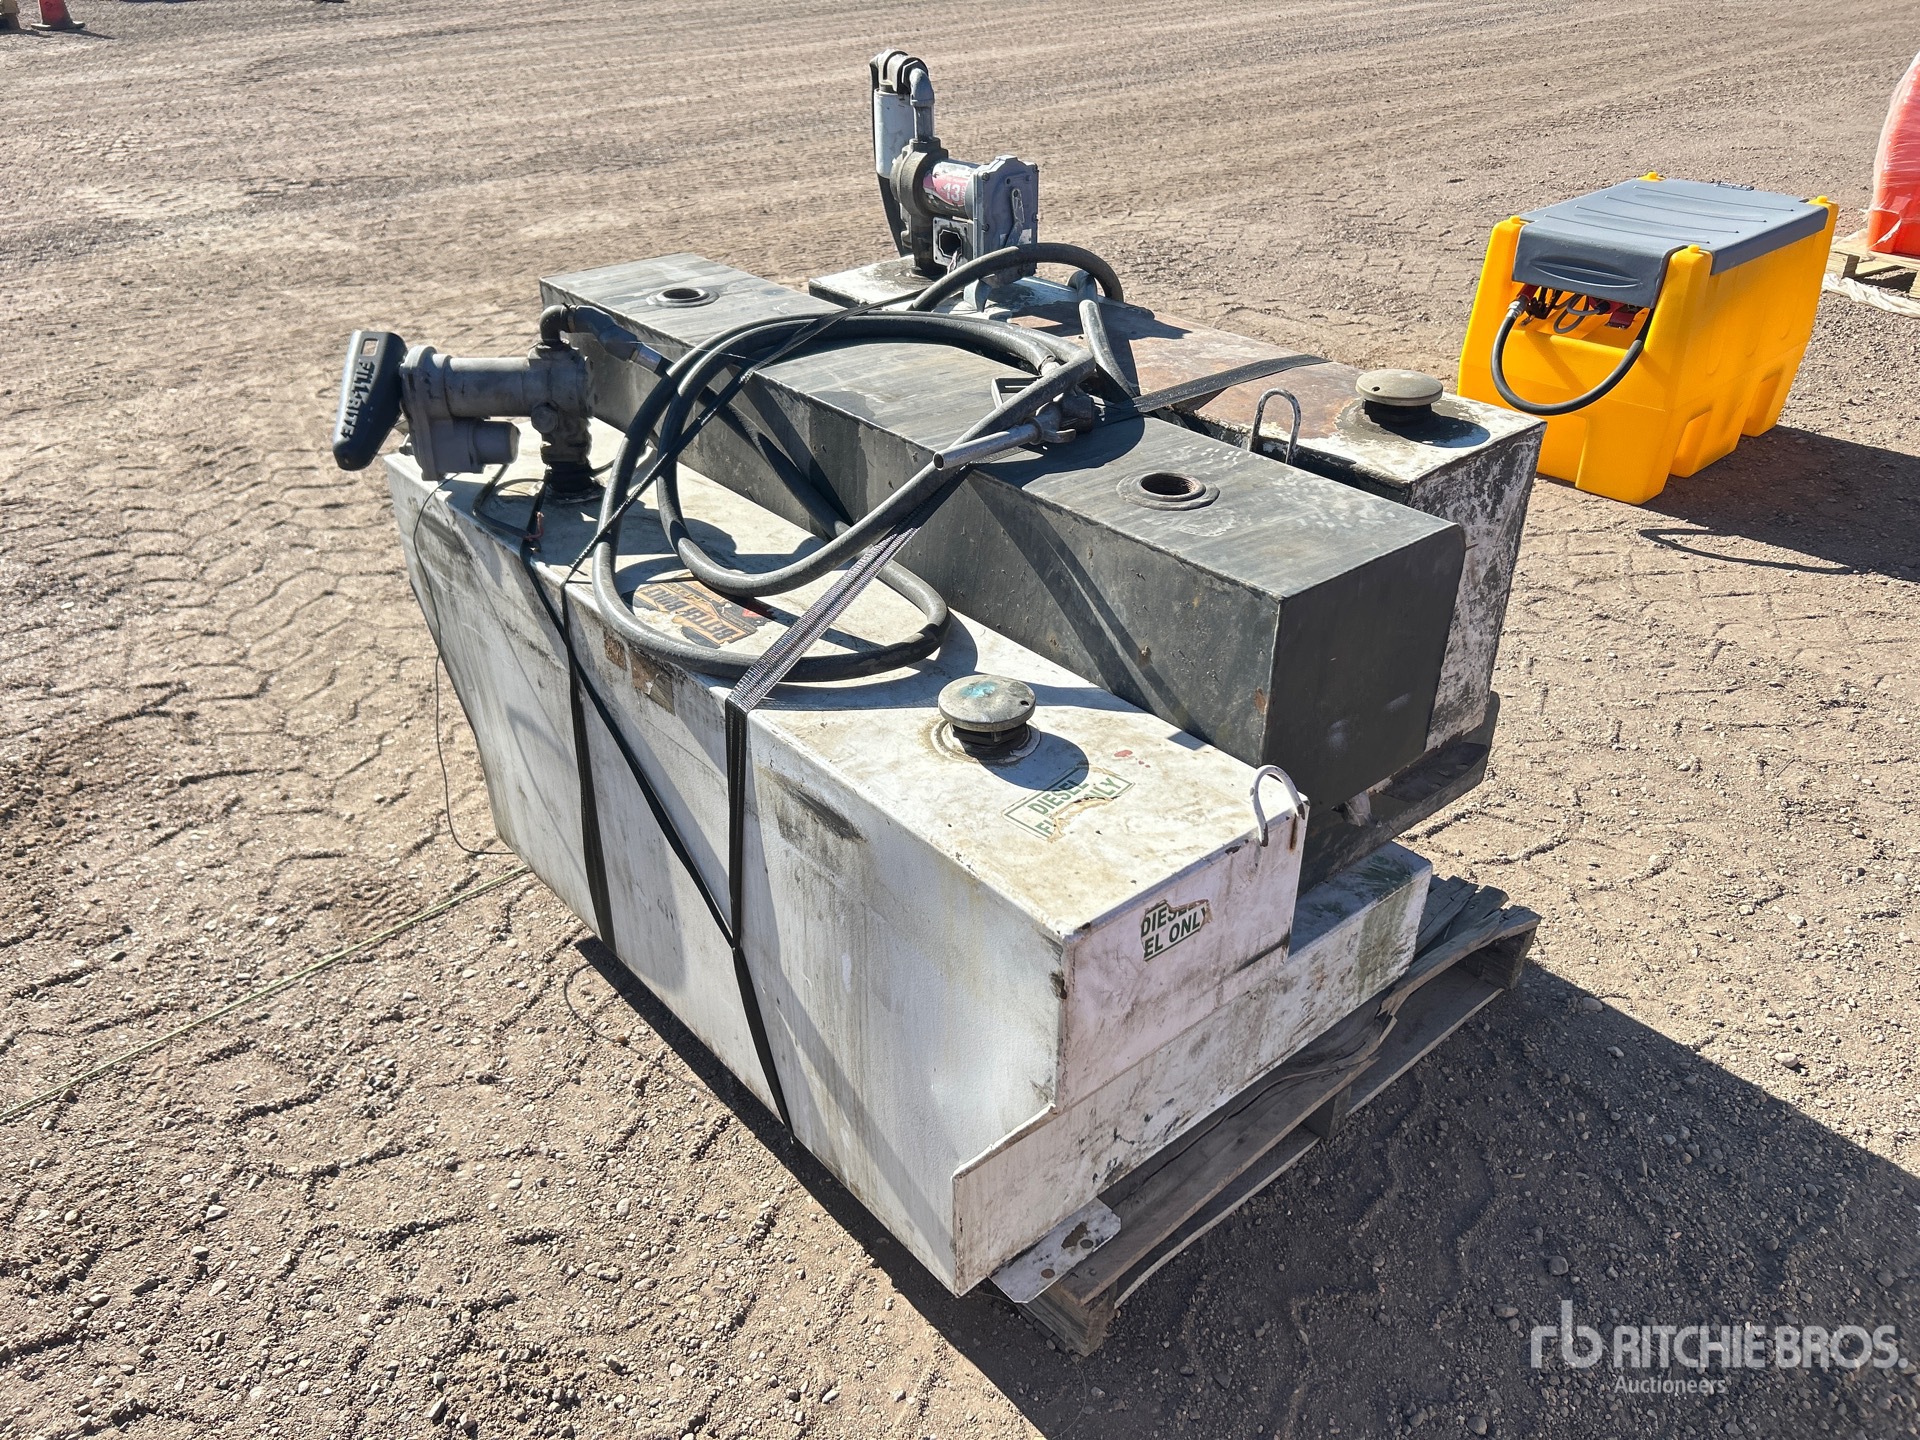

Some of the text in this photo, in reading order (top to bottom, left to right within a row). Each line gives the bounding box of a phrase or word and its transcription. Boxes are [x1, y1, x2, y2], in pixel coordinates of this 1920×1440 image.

[340, 359, 372, 438] FILL-RITE
[676, 606, 739, 641] BETTER
[1027, 779, 1089, 815] DIESEL
